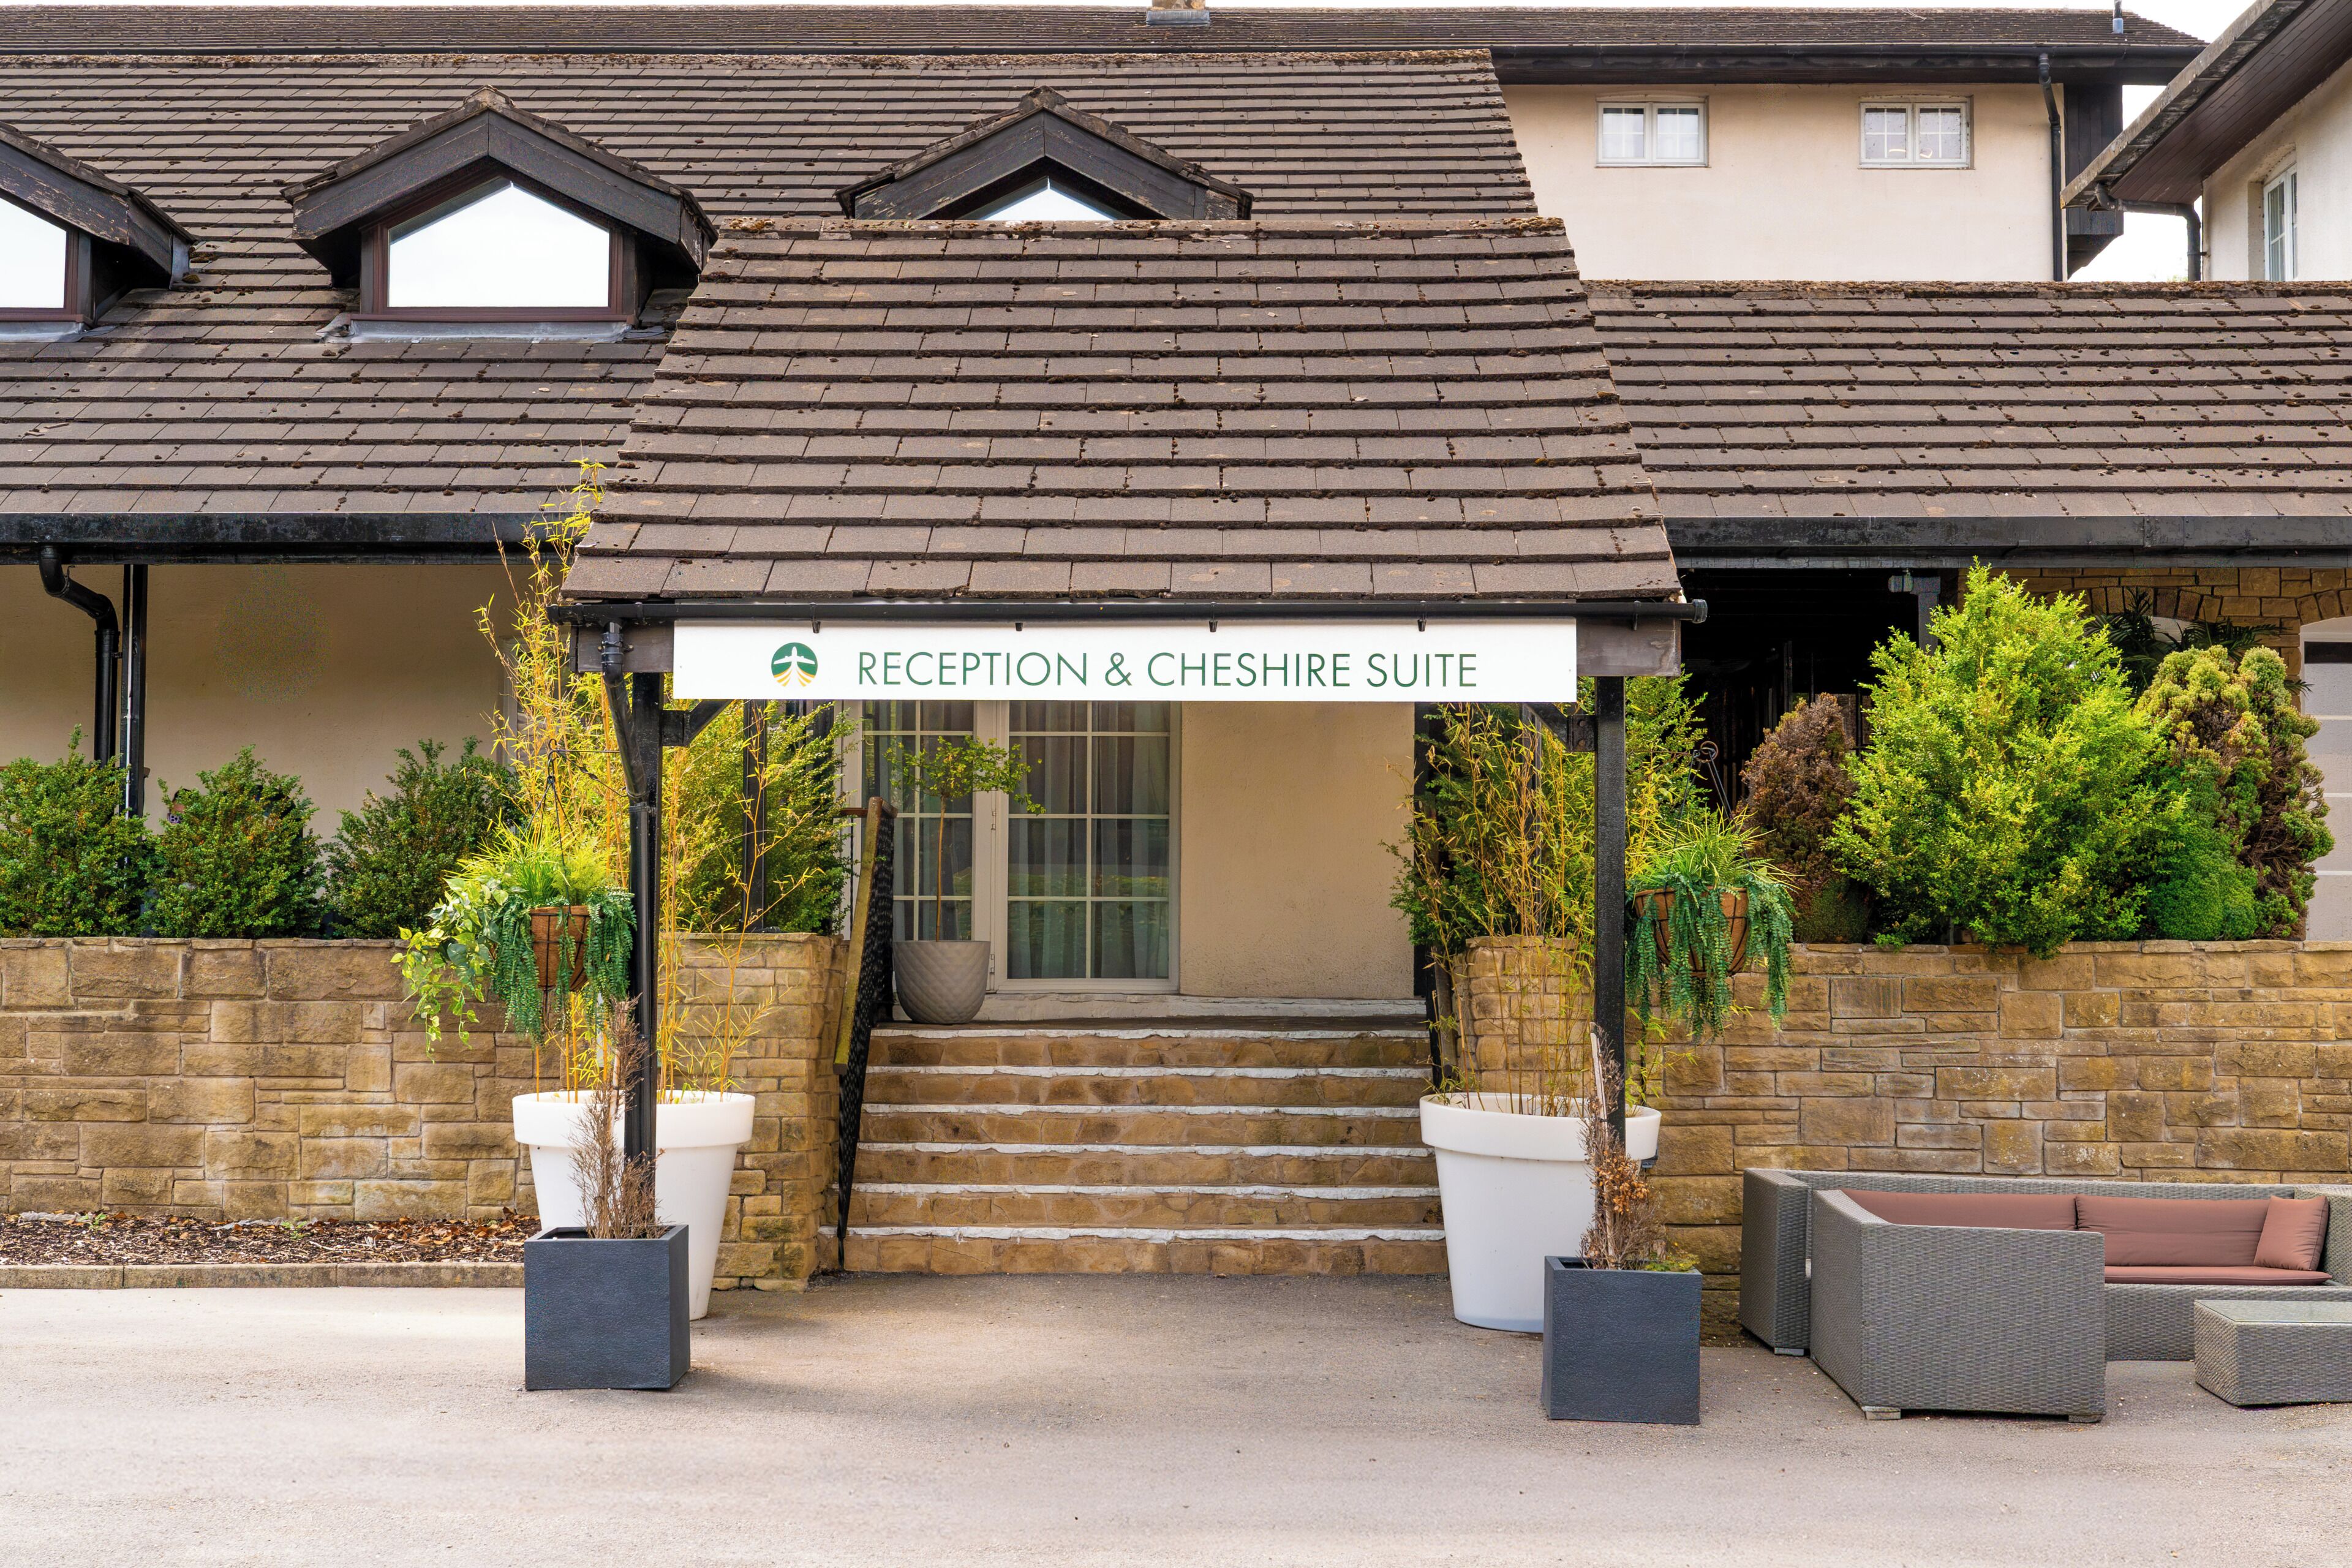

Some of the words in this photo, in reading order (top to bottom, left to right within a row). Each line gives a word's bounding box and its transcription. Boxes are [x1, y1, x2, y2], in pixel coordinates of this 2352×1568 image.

[859, 652, 1087, 686] RECEPTION
[1105, 652, 1132, 687] &
[1147, 652, 1350, 687] CHESHIRE
[1366, 653, 1477, 688] SUITE
